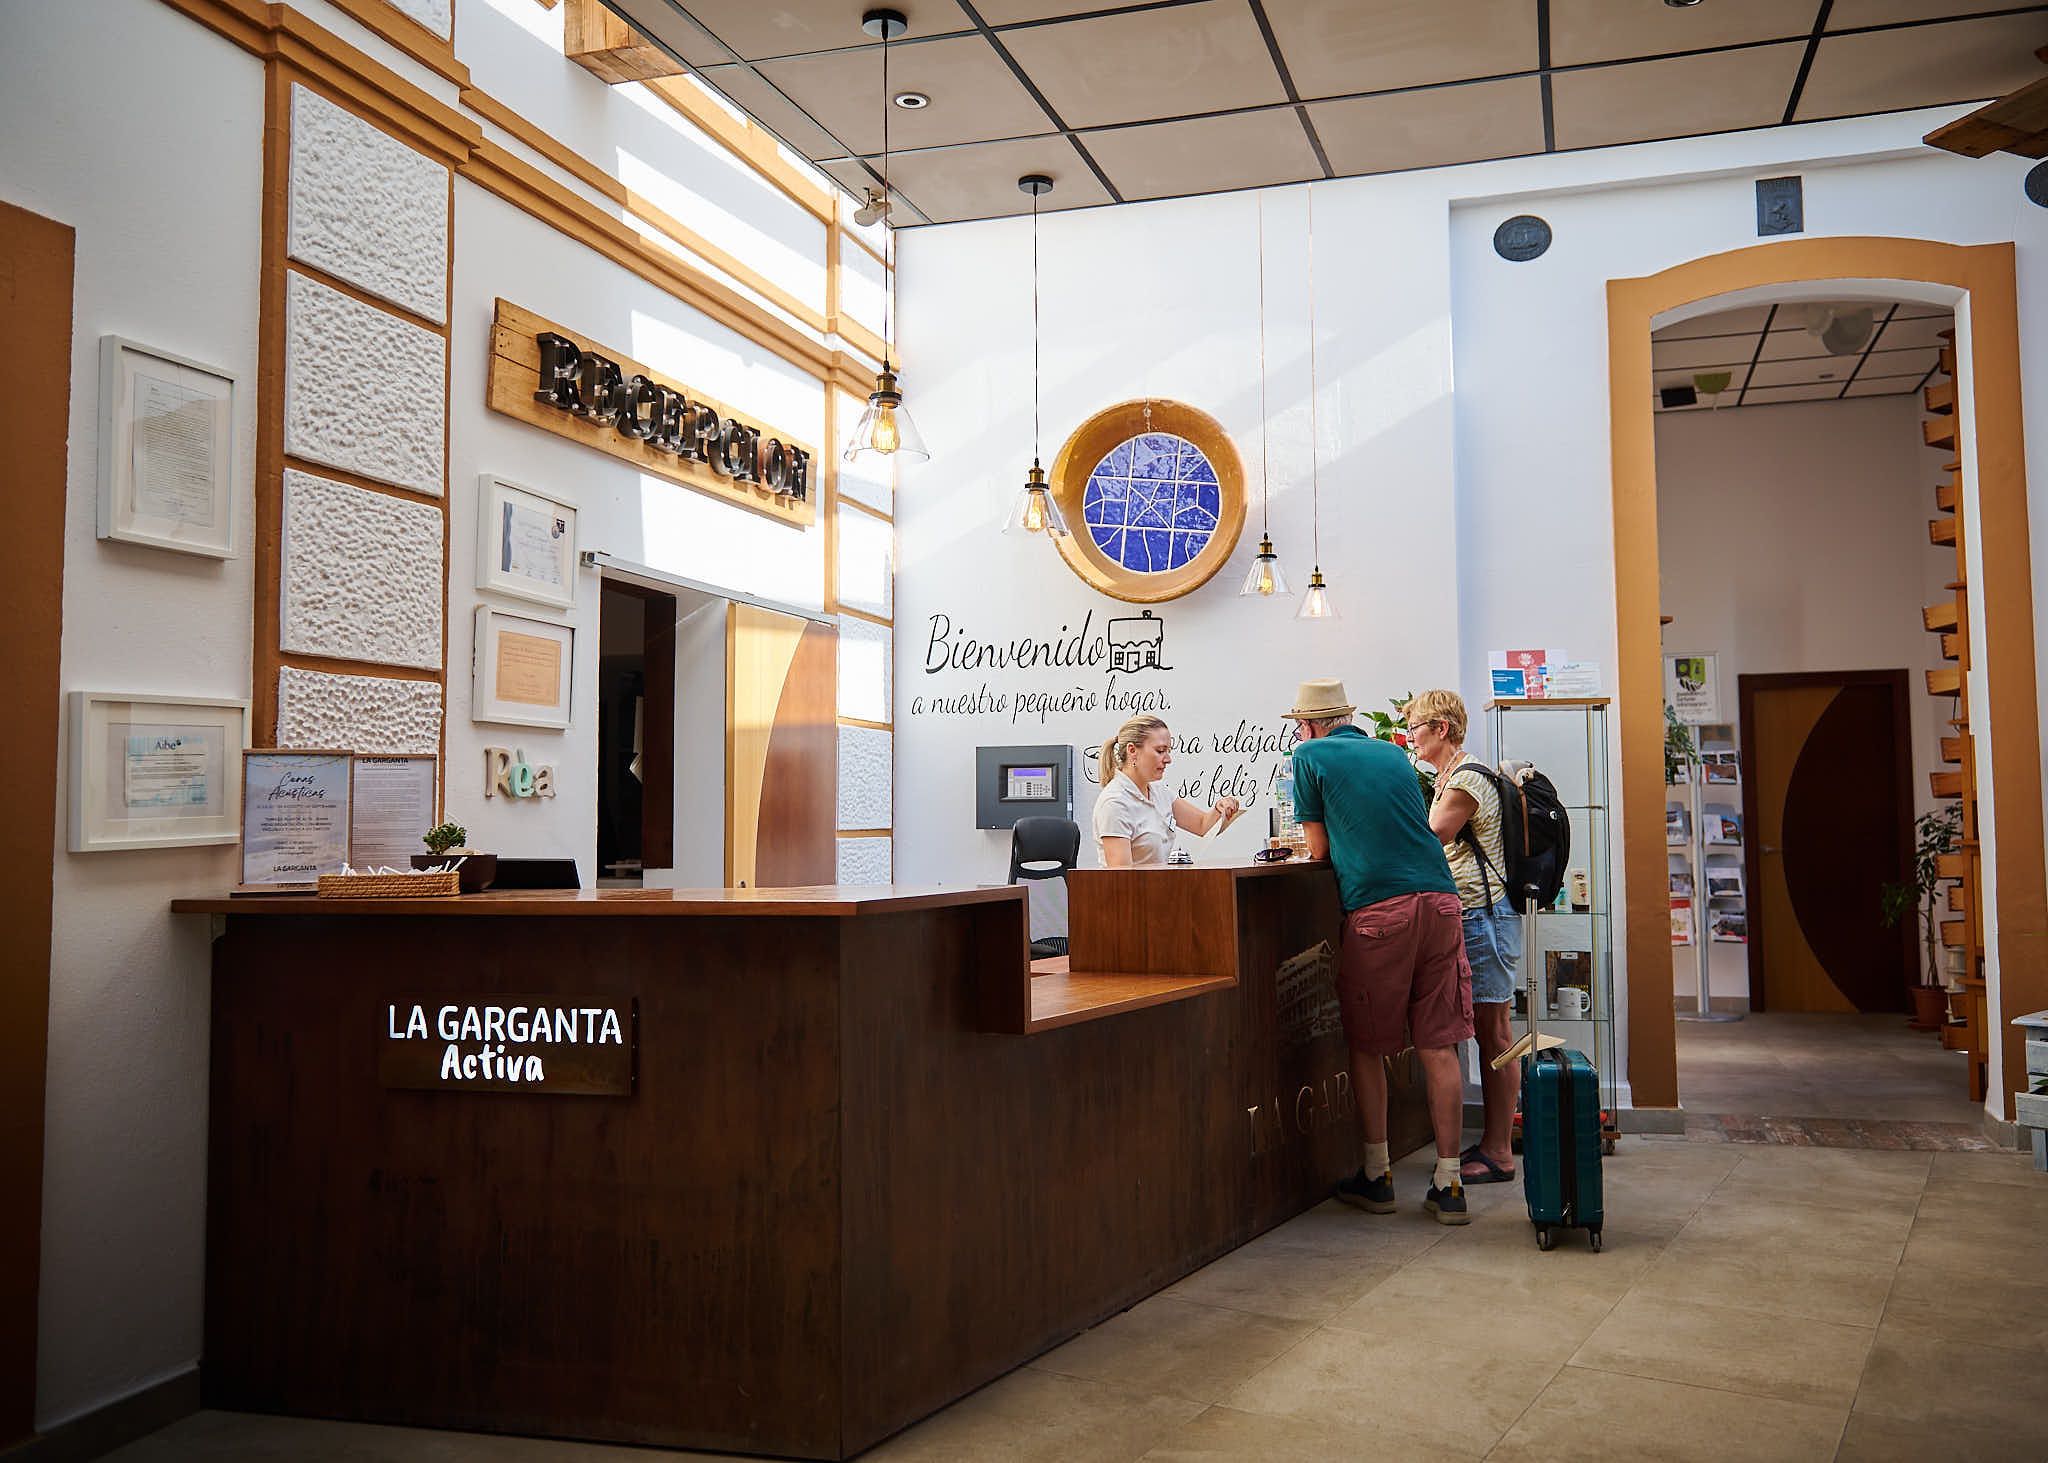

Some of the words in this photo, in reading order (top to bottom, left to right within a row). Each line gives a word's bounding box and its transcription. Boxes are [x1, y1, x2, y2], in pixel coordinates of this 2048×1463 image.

[926, 609, 1106, 674] Bienvenido
[911, 696, 925, 715] a
[932, 682, 1008, 715] nuestro
[1012, 687, 1099, 724] pequeño
[1105, 675, 1172, 715] hogar.
[1178, 770, 1204, 798] sé
[1208, 764, 1257, 808] feliz
[389, 1005, 428, 1040] LA
[437, 1005, 623, 1044] GARGANTA
[440, 1043, 545, 1082] Activa
